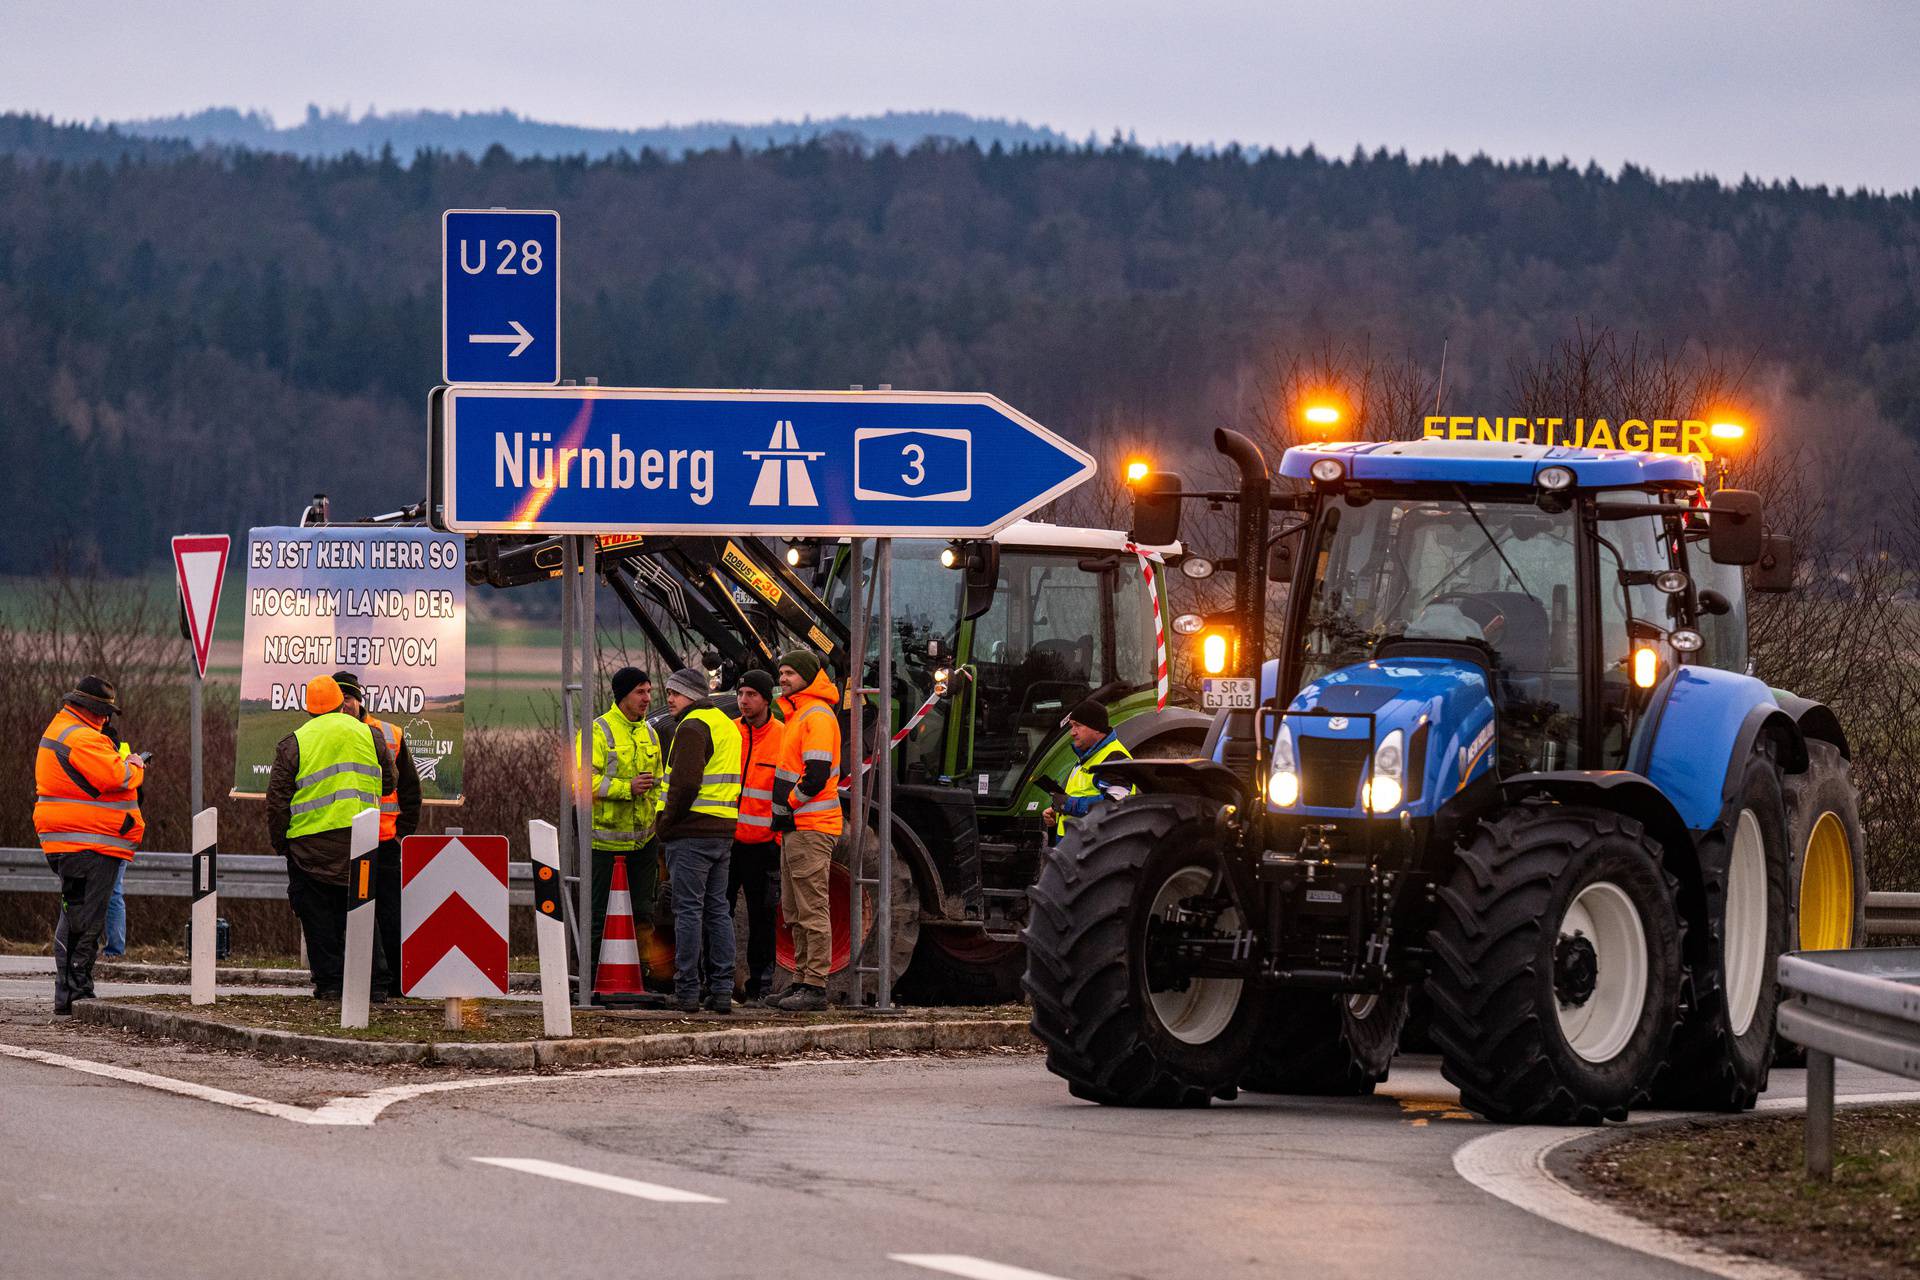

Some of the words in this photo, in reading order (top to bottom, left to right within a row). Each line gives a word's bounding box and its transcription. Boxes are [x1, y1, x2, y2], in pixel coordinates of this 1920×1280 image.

[460, 239, 487, 275] U
[496, 239, 543, 275] 28
[494, 431, 715, 506] Nürnberg
[901, 443, 926, 486] 3
[251, 541, 273, 569] ES
[276, 541, 312, 569] IST
[316, 541, 365, 569] KEIN
[370, 541, 426, 569] HERR
[428, 541, 459, 570] SO
[723, 551, 757, 579] ROBUST
[251, 588, 310, 616] HOCH
[316, 588, 342, 616] IM
[346, 588, 410, 620] LAND,
[414, 589, 455, 618] DER
[264, 635, 332, 664] NICHT
[334, 636, 385, 665] LEBT
[388, 637, 438, 666] VOM
[1206, 694, 1223, 707] GJ
[1228, 694, 1252, 707] 103
[1221, 681, 1237, 693] SR
[436, 740, 453, 755] LSV
